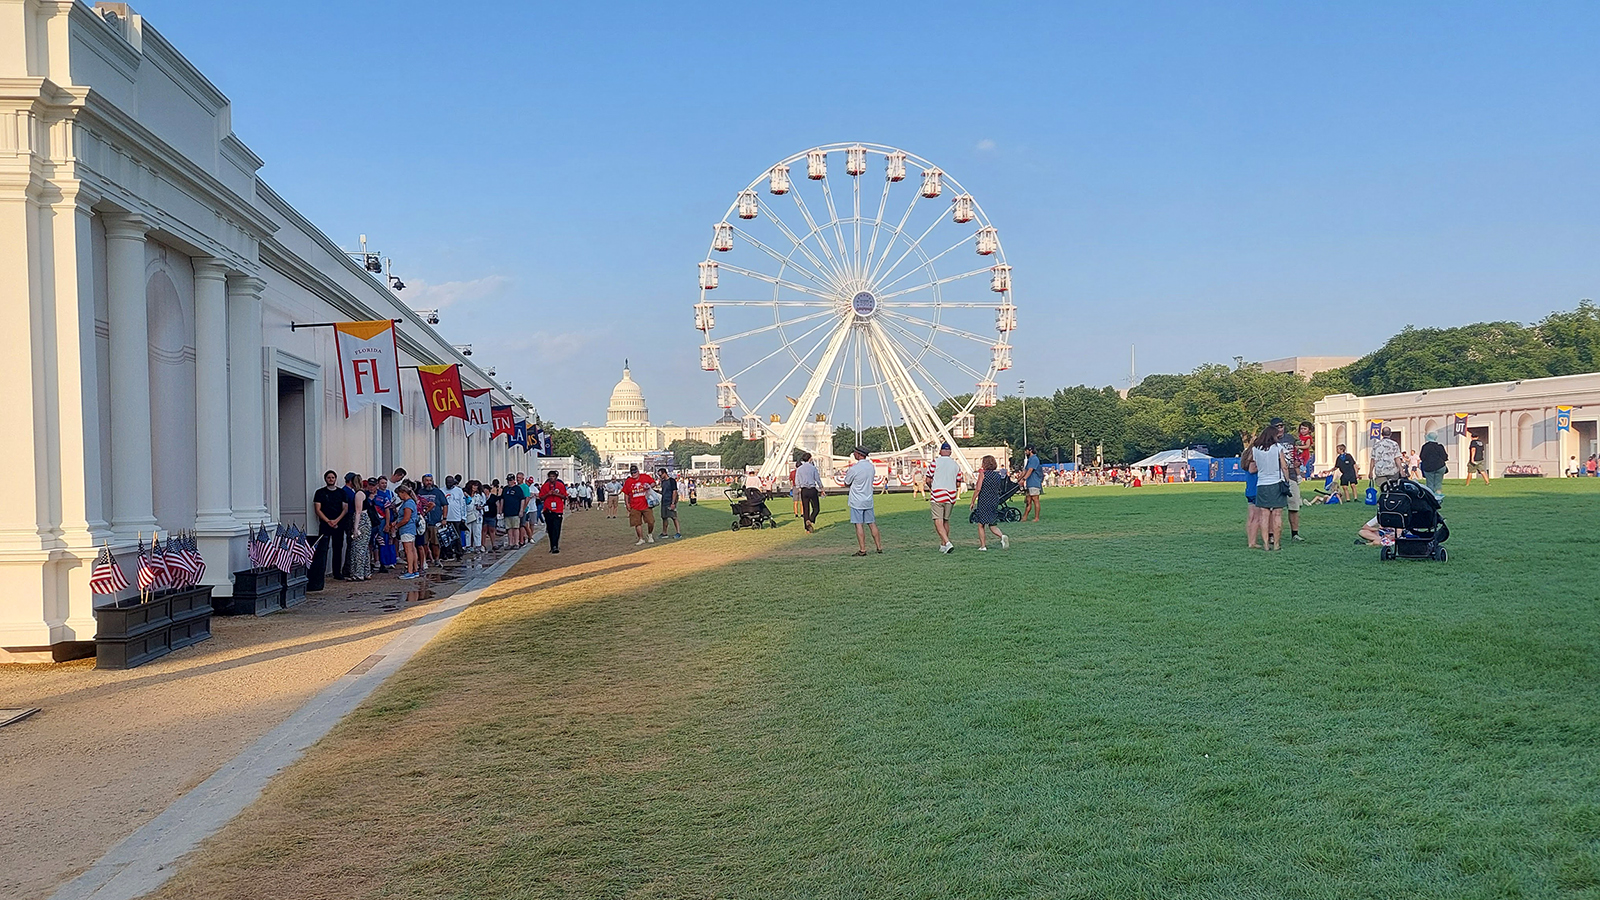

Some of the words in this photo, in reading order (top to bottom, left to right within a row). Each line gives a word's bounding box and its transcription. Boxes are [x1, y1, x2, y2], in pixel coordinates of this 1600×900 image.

[354, 347, 382, 355] FLORIDA
[351, 358, 390, 395] FL
[432, 387, 461, 412] GA
[469, 408, 489, 425] AL
[492, 416, 511, 430] TN
[1558, 416, 1569, 427] SD
[1455, 423, 1466, 433] UT
